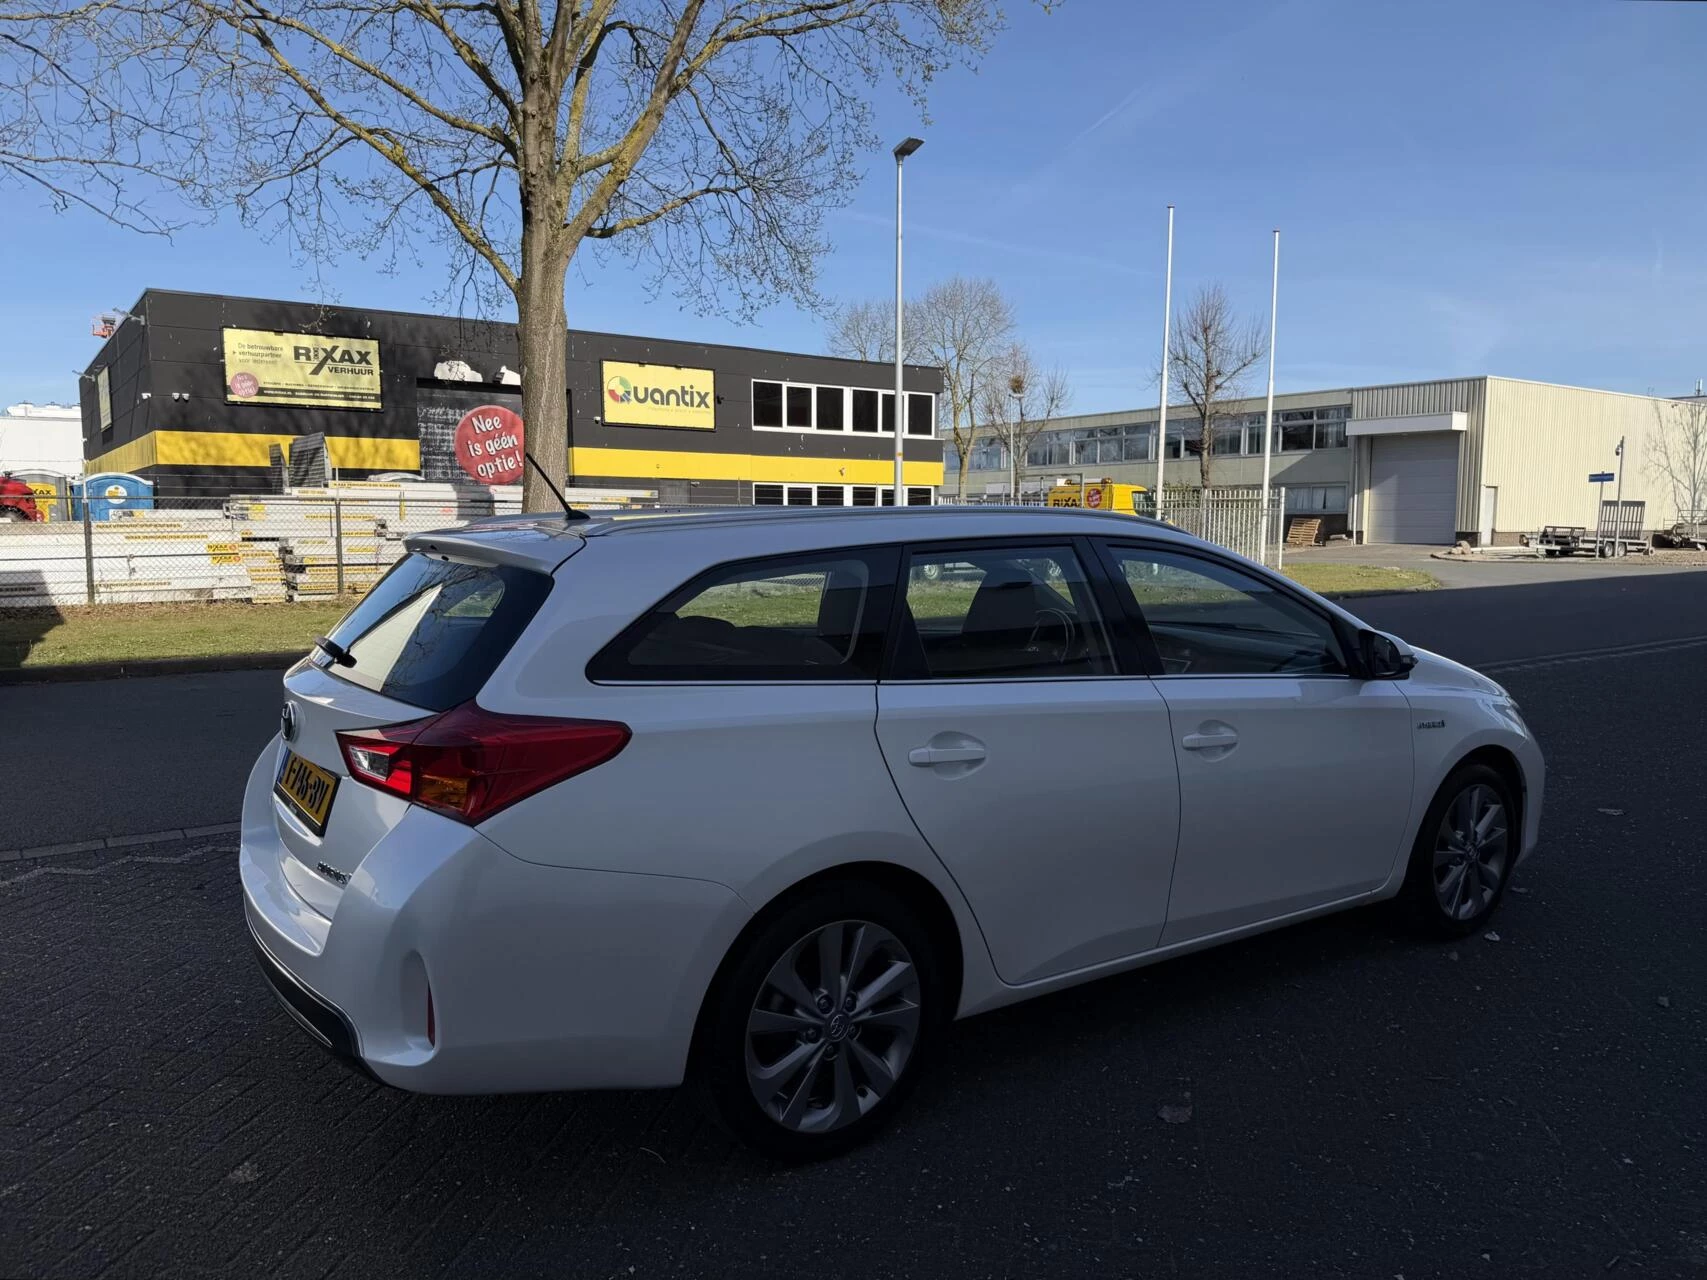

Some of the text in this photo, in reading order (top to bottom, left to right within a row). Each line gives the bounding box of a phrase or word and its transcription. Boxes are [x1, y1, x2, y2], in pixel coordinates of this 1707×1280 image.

[328, 366, 374, 376] VERHUUR
[471, 415, 502, 434] Nee
[467, 431, 518, 457] is géén
[477, 450, 524, 479] optie!
[1053, 496, 1081, 507] RIXA
